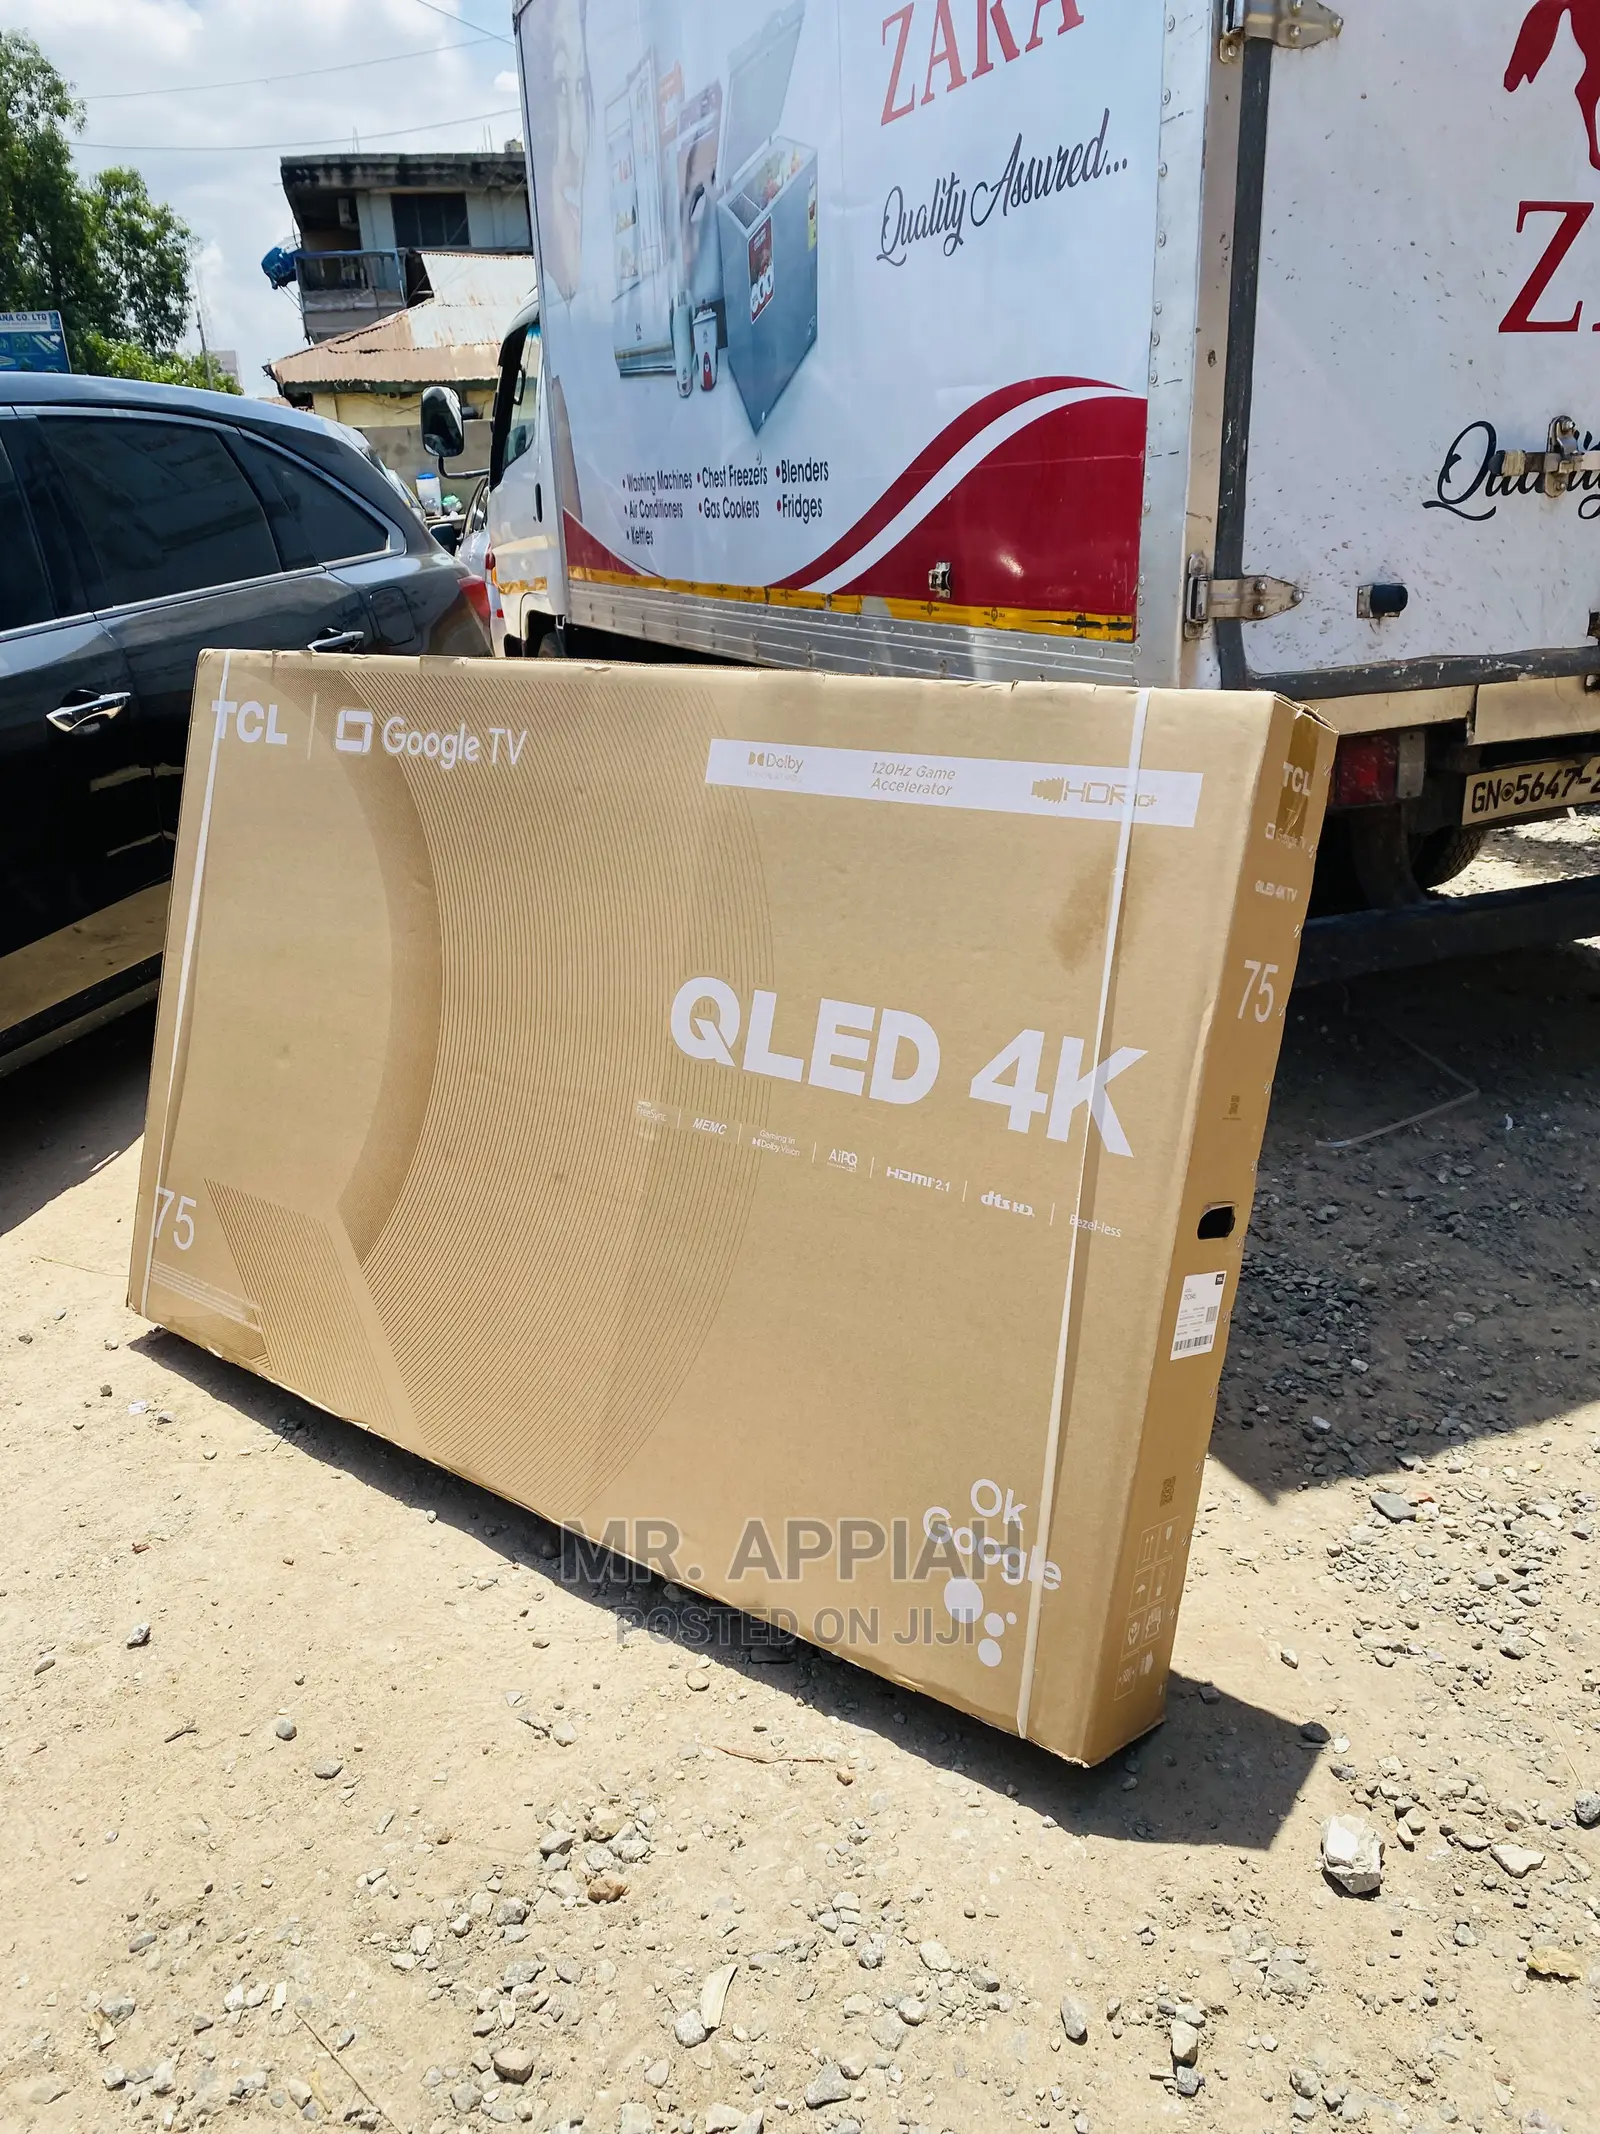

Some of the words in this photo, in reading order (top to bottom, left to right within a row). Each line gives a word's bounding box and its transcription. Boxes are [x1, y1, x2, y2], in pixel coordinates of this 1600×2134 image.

[876, 172, 967, 267] Quality
[970, 107, 1128, 227] Assured...
[1498, 200, 1600, 333] Z
[31, 313, 47, 321] LTD
[702, 465, 727, 489] Chest
[729, 464, 768, 488] Freezers
[781, 457, 829, 484] Blenders
[626, 473, 656, 496] Washing
[656, 470, 693, 490] Machines
[629, 500, 638, 519] Air
[639, 499, 684, 519] Conditioners
[704, 497, 720, 519] Gas
[723, 496, 760, 519] Cookers
[782, 494, 823, 524] Fridges
[630, 526, 654, 545] Kettles
[211, 700, 288, 745] TCL
[383, 716, 480, 769] Google
[489, 728, 527, 765] TV
[766, 753, 804, 773] Dolby
[871, 762, 912, 777] 120Hz
[916, 765, 956, 780] Game
[871, 778, 953, 796] Accelerator
[1282, 761, 1311, 796] TCL
[1286, 887, 1298, 903] TV
[1238, 959, 1279, 1023] 75
[670, 976, 940, 1104] QLED
[969, 1028, 1149, 1158] 4K
[636, 1106, 667, 1123] FreeSync
[692, 1117, 727, 1135] MEMC
[760, 1130, 788, 1145] Gaming
[760, 1139, 780, 1153] Dolby
[780, 1142, 800, 1157] Vision
[935, 1178, 950, 1192] 2.1
[155, 1184, 196, 1250] 75
[1069, 1214, 1121, 1237] Bezel-less
[970, 1478, 1028, 1531] Ok
[923, 1505, 1062, 1591] Google
